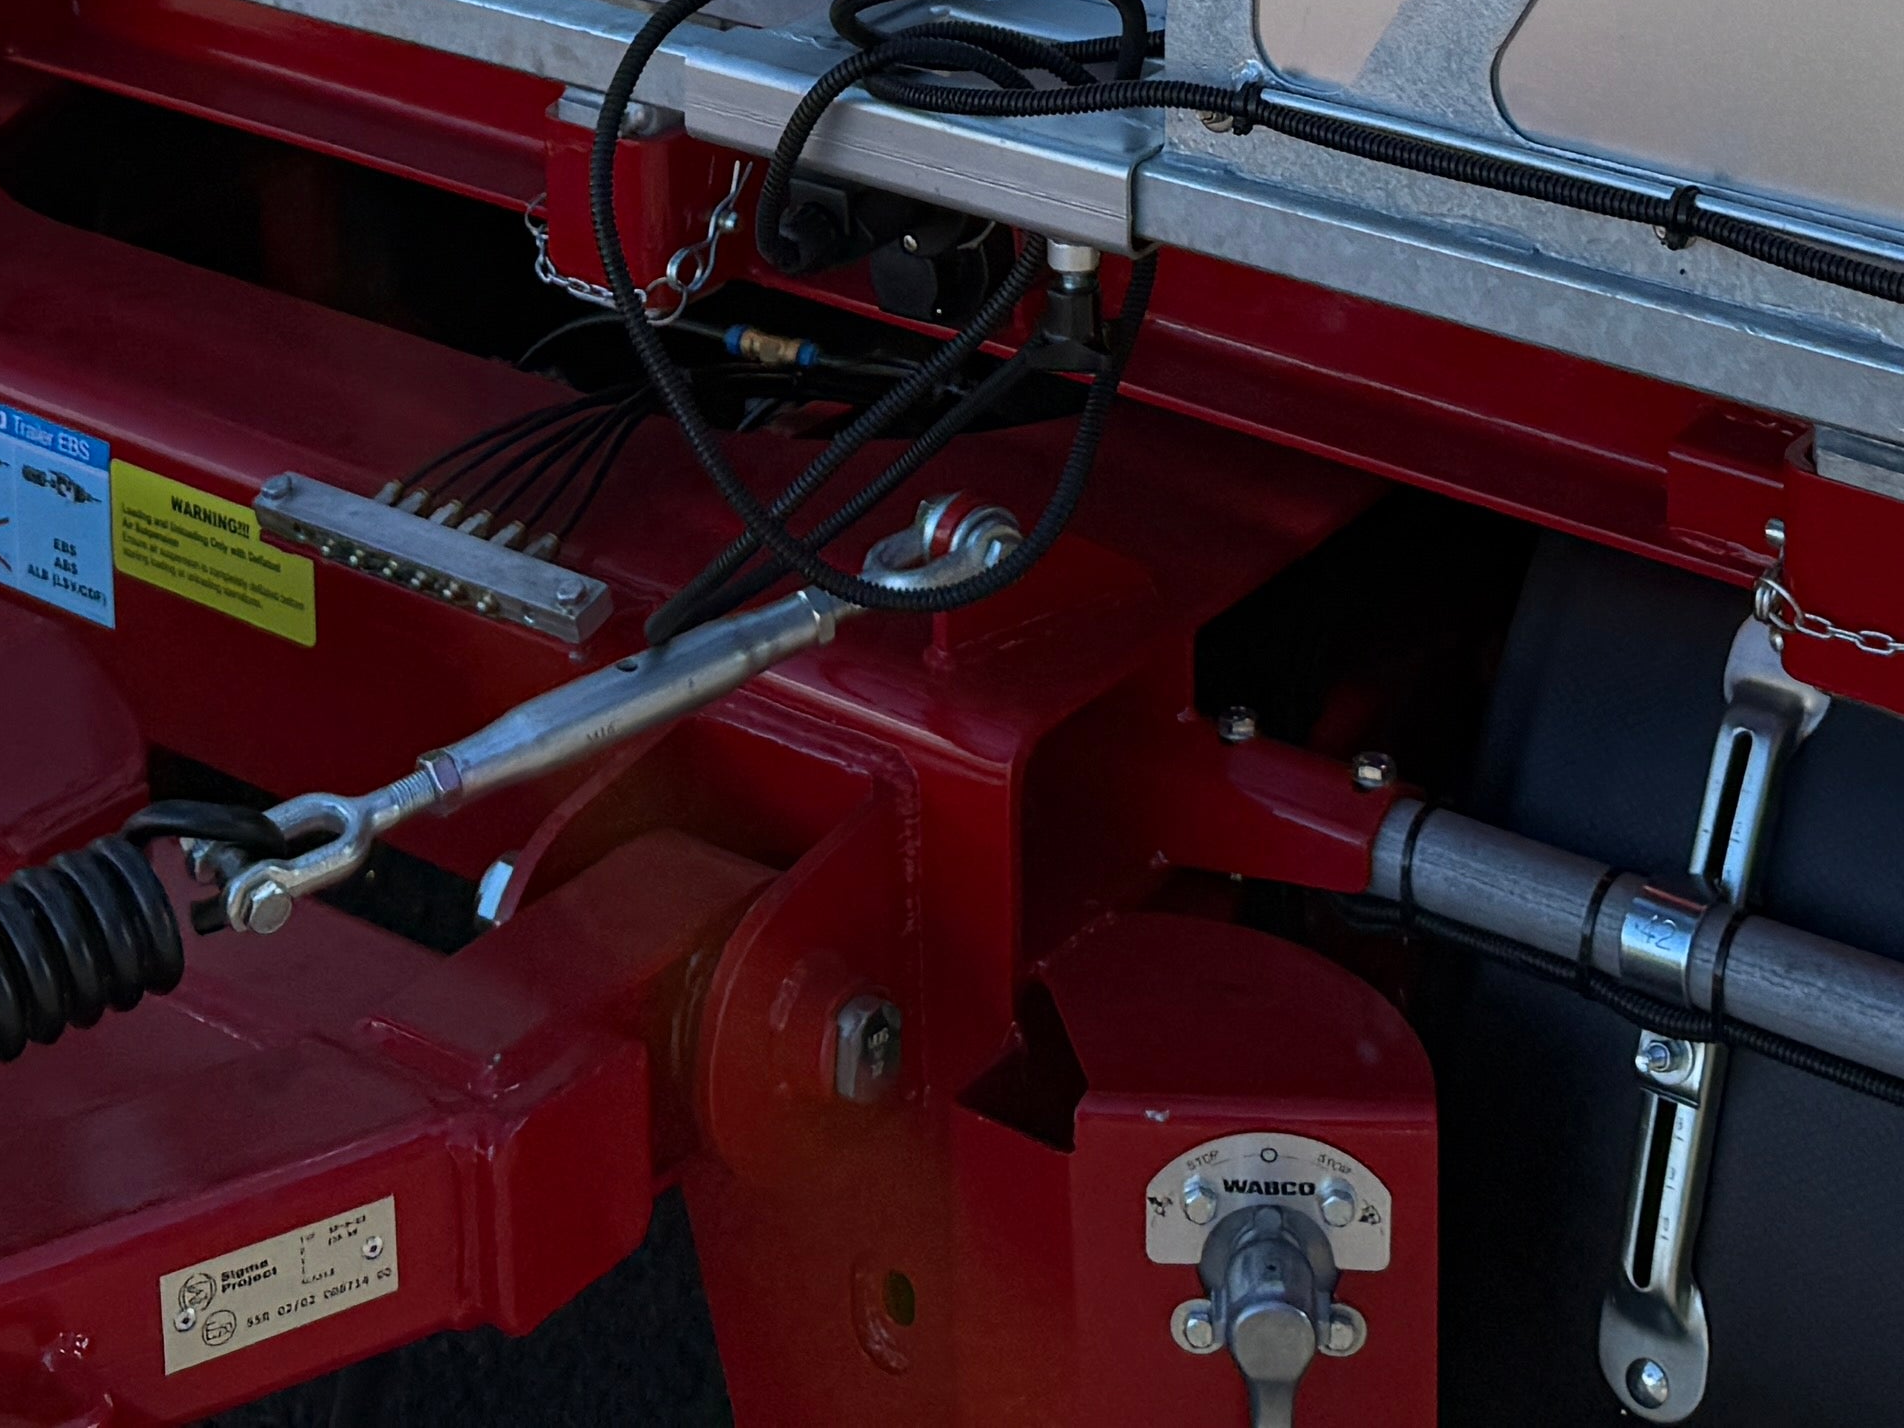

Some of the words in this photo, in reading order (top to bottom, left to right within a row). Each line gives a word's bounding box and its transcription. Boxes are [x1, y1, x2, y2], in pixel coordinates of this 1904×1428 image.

[58, 431, 90, 461] EBS
[171, 495, 250, 539] WARNING!!!
[53, 537, 76, 557] EBS
[1187, 1150, 1219, 1171] STOP
[1223, 1177, 1316, 1196] WABCO
[221, 1259, 269, 1283] Sigma
[221, 1266, 278, 1294] Project
